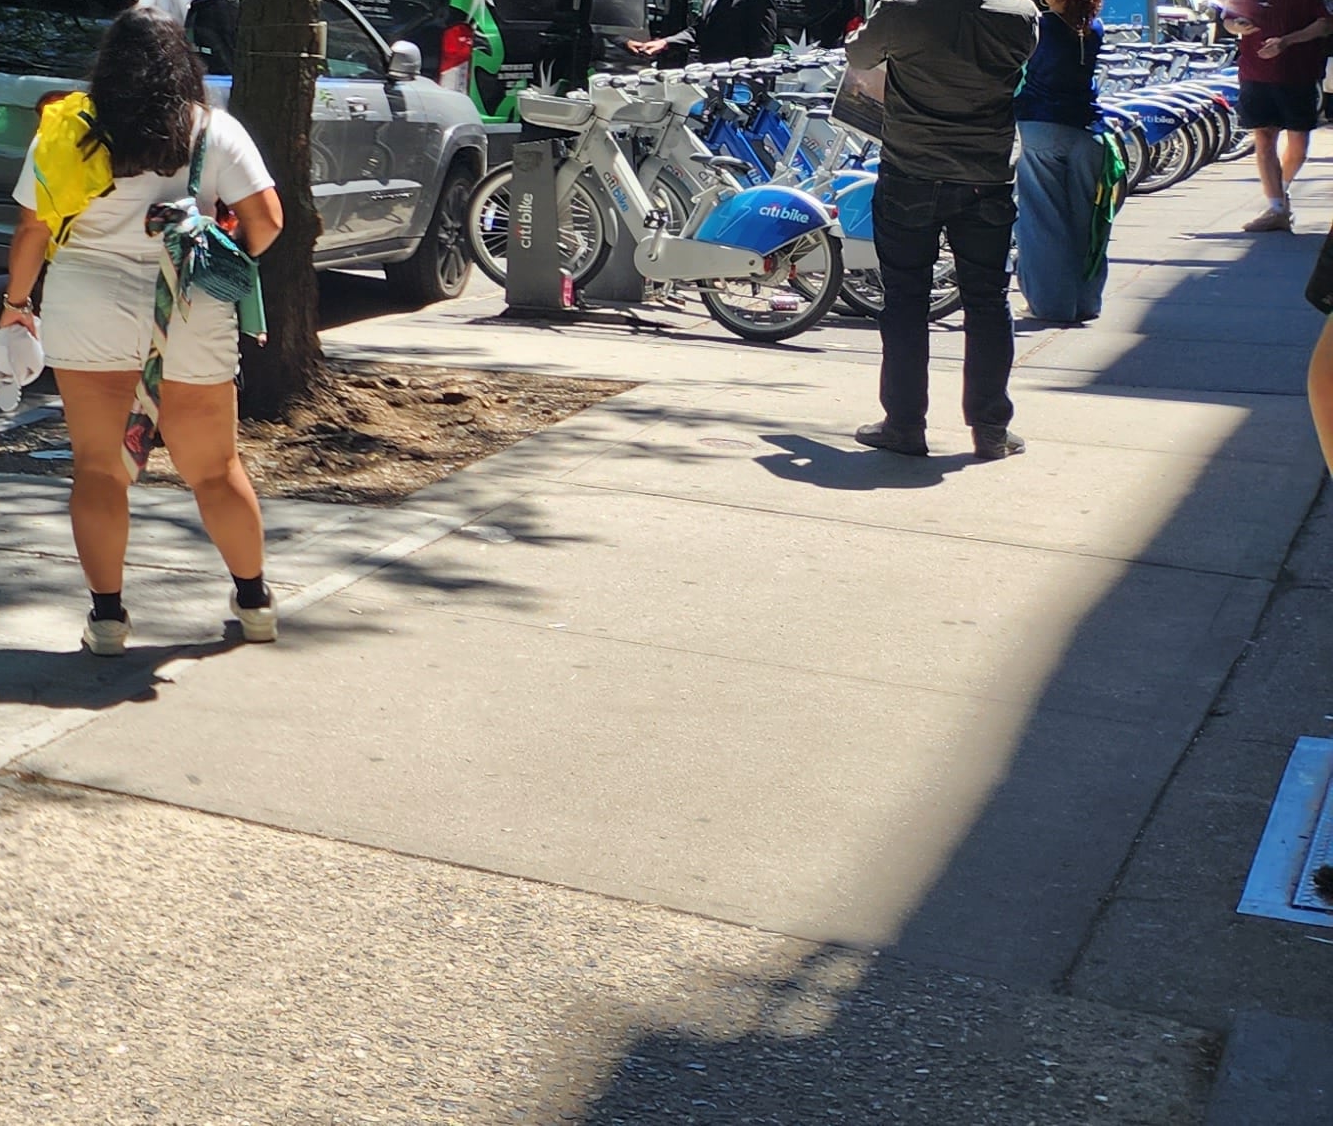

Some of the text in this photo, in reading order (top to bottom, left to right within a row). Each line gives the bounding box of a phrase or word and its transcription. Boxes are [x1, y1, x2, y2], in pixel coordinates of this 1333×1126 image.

[603, 172, 630, 212] citi bike
[515, 192, 534, 249] citi bike
[759, 203, 810, 224] citi bike
